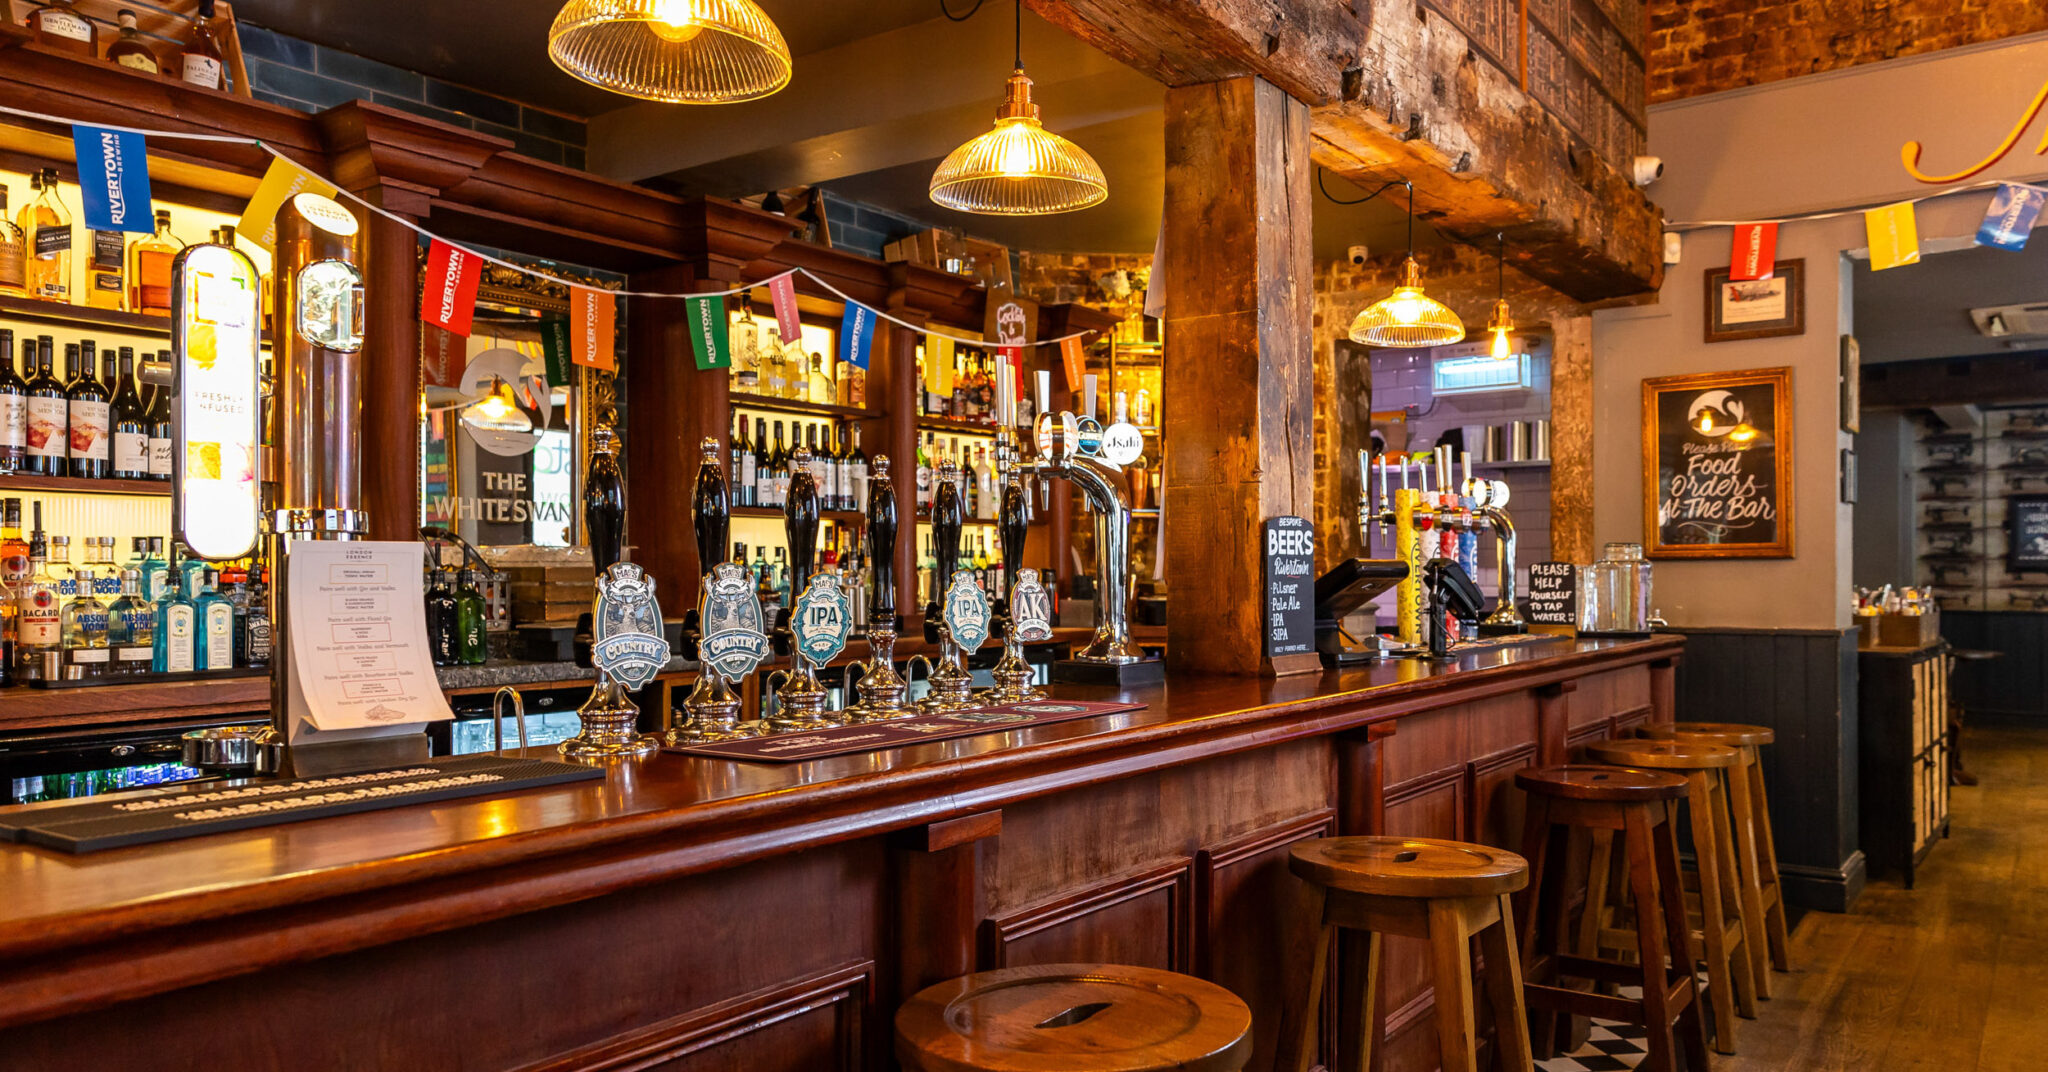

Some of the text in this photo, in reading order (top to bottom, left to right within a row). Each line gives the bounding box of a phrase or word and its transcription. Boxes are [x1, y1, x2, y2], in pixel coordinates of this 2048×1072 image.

[100, 132, 124, 225] RIVERTOWN
[439, 249, 461, 324] RIVERTOWN
[586, 292, 596, 362] RIVERTOWN
[699, 298, 716, 364] RIVERTOWN
[850, 306, 863, 362] RIVERTOWN
[1107, 436, 1140, 448] Asahi
[1682, 442, 1720, 455] Please
[1687, 452, 1742, 477] Food
[483, 471, 526, 491] THE
[1669, 474, 1759, 498] Orders
[1662, 496, 1777, 521] At The Bar
[1278, 517, 1303, 527] BESPOKE
[1268, 529, 1314, 556] BEERS
[1274, 556, 1310, 576] Rivertown
[1531, 563, 1571, 576] PLEASE
[1272, 581, 1299, 595] Pilsner
[1534, 576, 1563, 590] HELP
[1271, 595, 1301, 611] Pale Ale
[1530, 590, 1573, 601] YOURSELF
[23, 608, 60, 618] BACARD
[957, 599, 981, 618] IPA
[1017, 592, 1048, 622] AK
[1529, 601, 1564, 611] TO TAP
[76, 613, 110, 624] ABSOLU
[121, 612, 153, 623] ABSOLU
[809, 605, 839, 627] IPA
[1272, 613, 1285, 627] IPA
[1532, 612, 1567, 622] WATER
[1272, 628, 1289, 641] SIPA
[605, 640, 662, 661] COUNTRY
[710, 635, 761, 655] COUNTRY
